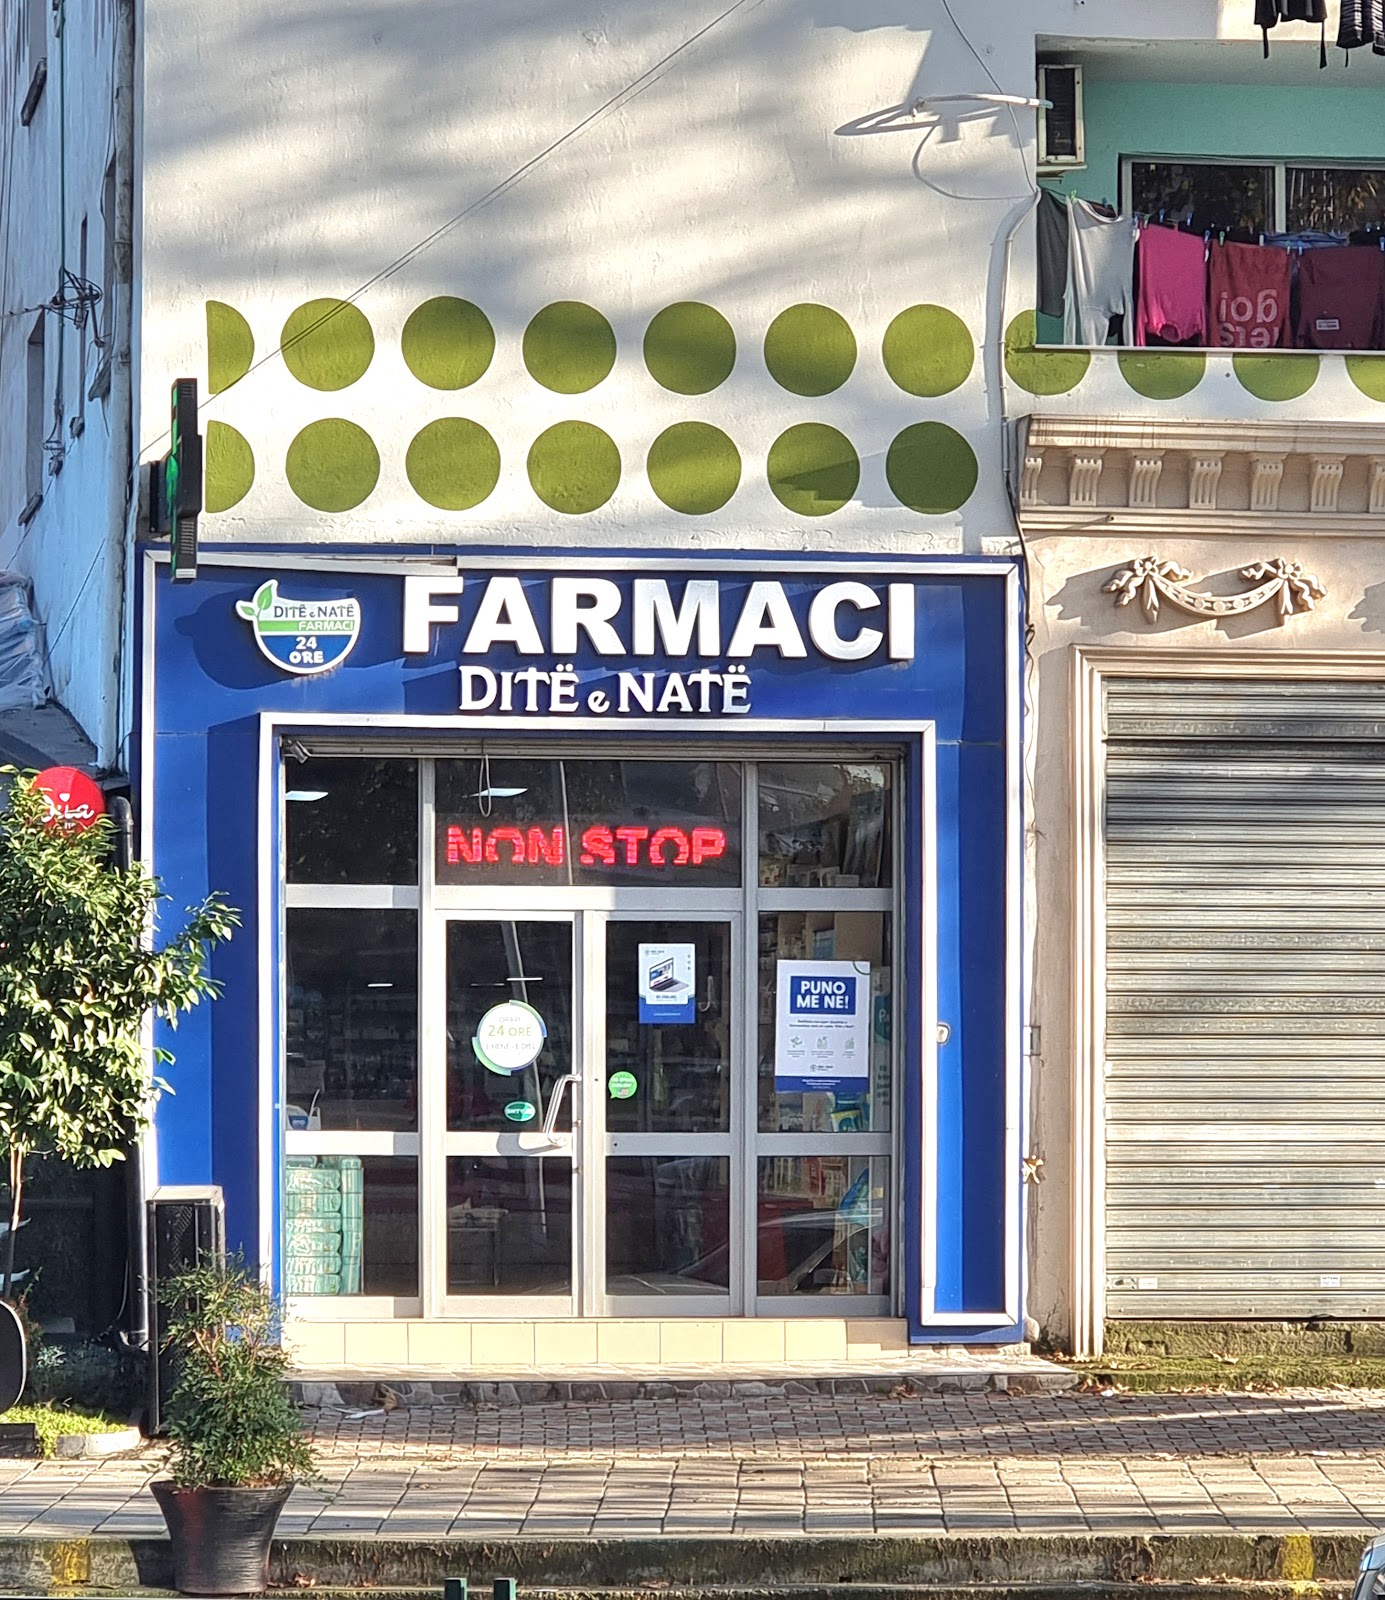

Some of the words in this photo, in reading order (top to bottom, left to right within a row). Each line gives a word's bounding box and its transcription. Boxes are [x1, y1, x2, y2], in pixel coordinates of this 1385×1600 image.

[273, 603, 307, 618] DITË
[317, 603, 354, 618] NATË
[403, 576, 915, 661] FARMACI
[299, 621, 353, 631] FARMACI
[295, 636, 317, 649] 24
[289, 650, 324, 664] ORE
[459, 664, 579, 713] DITË
[588, 690, 610, 713] e
[618, 664, 751, 714] NATË
[447, 825, 564, 864] NON
[580, 825, 726, 865] STOP
[801, 981, 846, 994] PUNO
[796, 995, 819, 1009] ME
[824, 996, 849, 1009] NE!
[487, 1024, 505, 1037] 24
[508, 1026, 532, 1037] ORE
